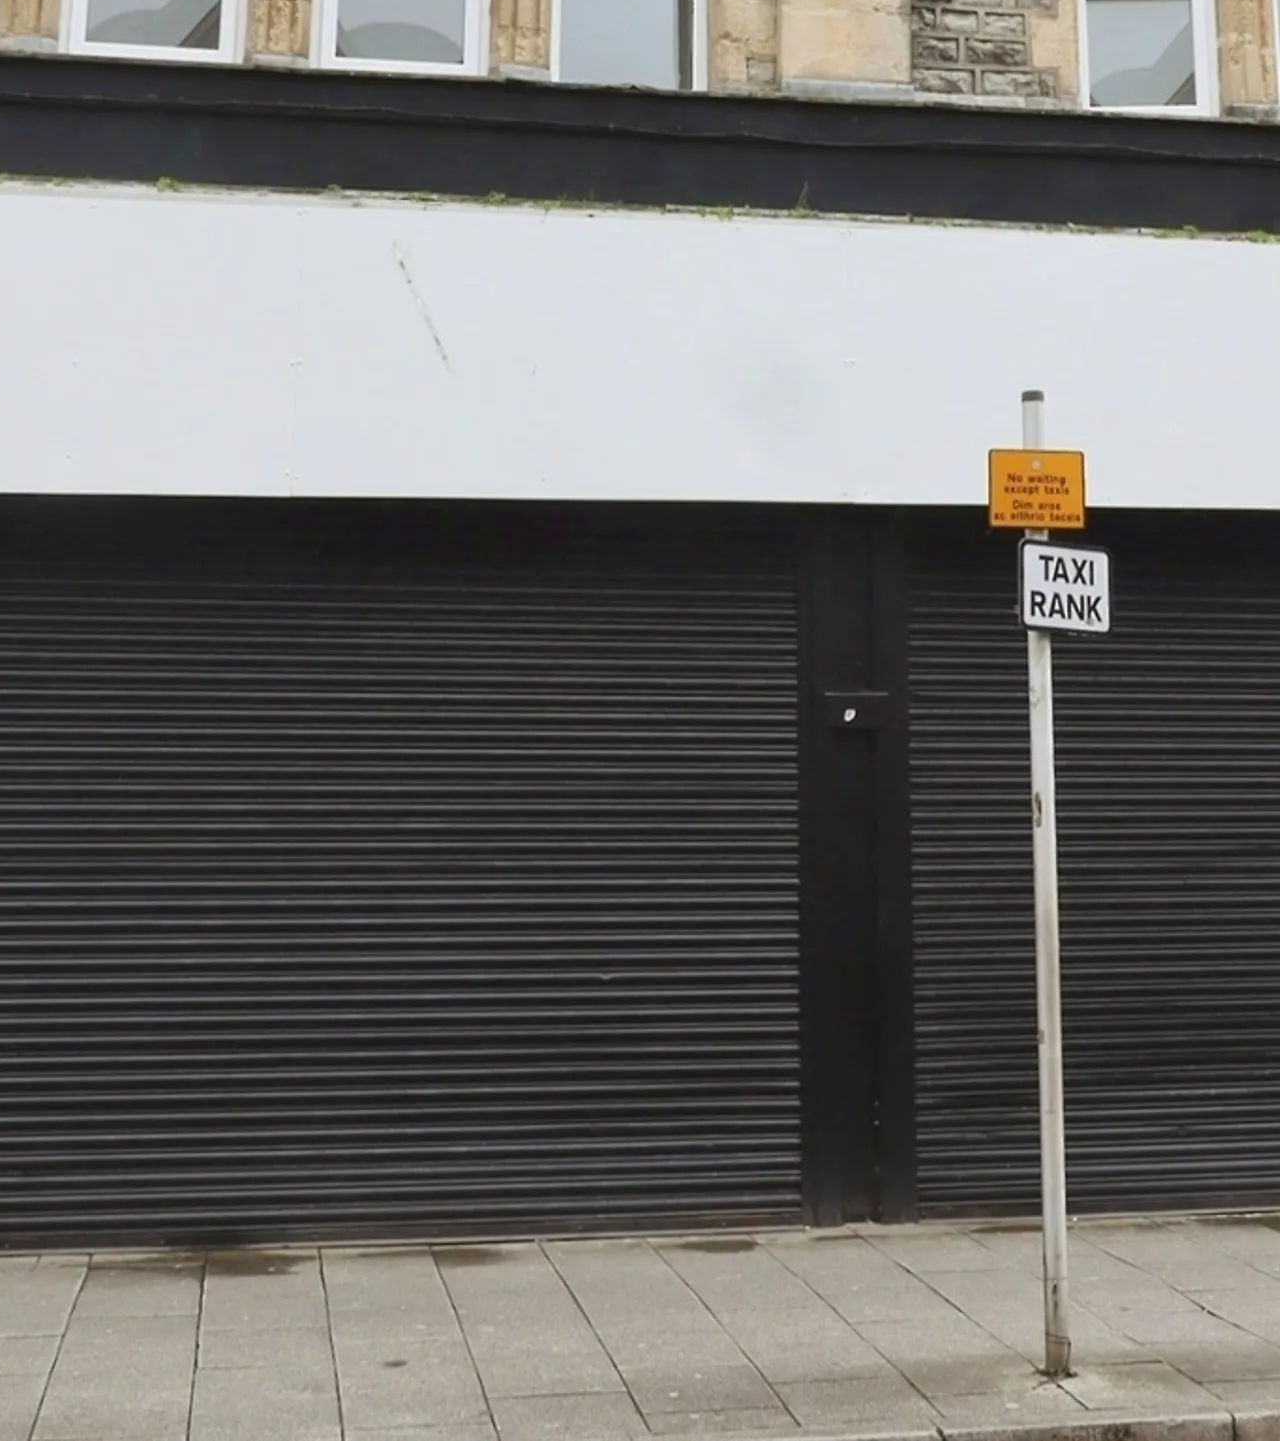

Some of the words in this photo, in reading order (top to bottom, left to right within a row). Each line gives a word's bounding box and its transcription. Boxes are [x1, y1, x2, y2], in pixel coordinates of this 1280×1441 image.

[1004, 486, 1040, 496] except
[1044, 486, 1070, 495] taxis
[1006, 472, 1023, 483] No
[1028, 474, 1067, 487] waiting
[1039, 554, 1095, 587] TAXI
[1030, 589, 1103, 623] RANK
